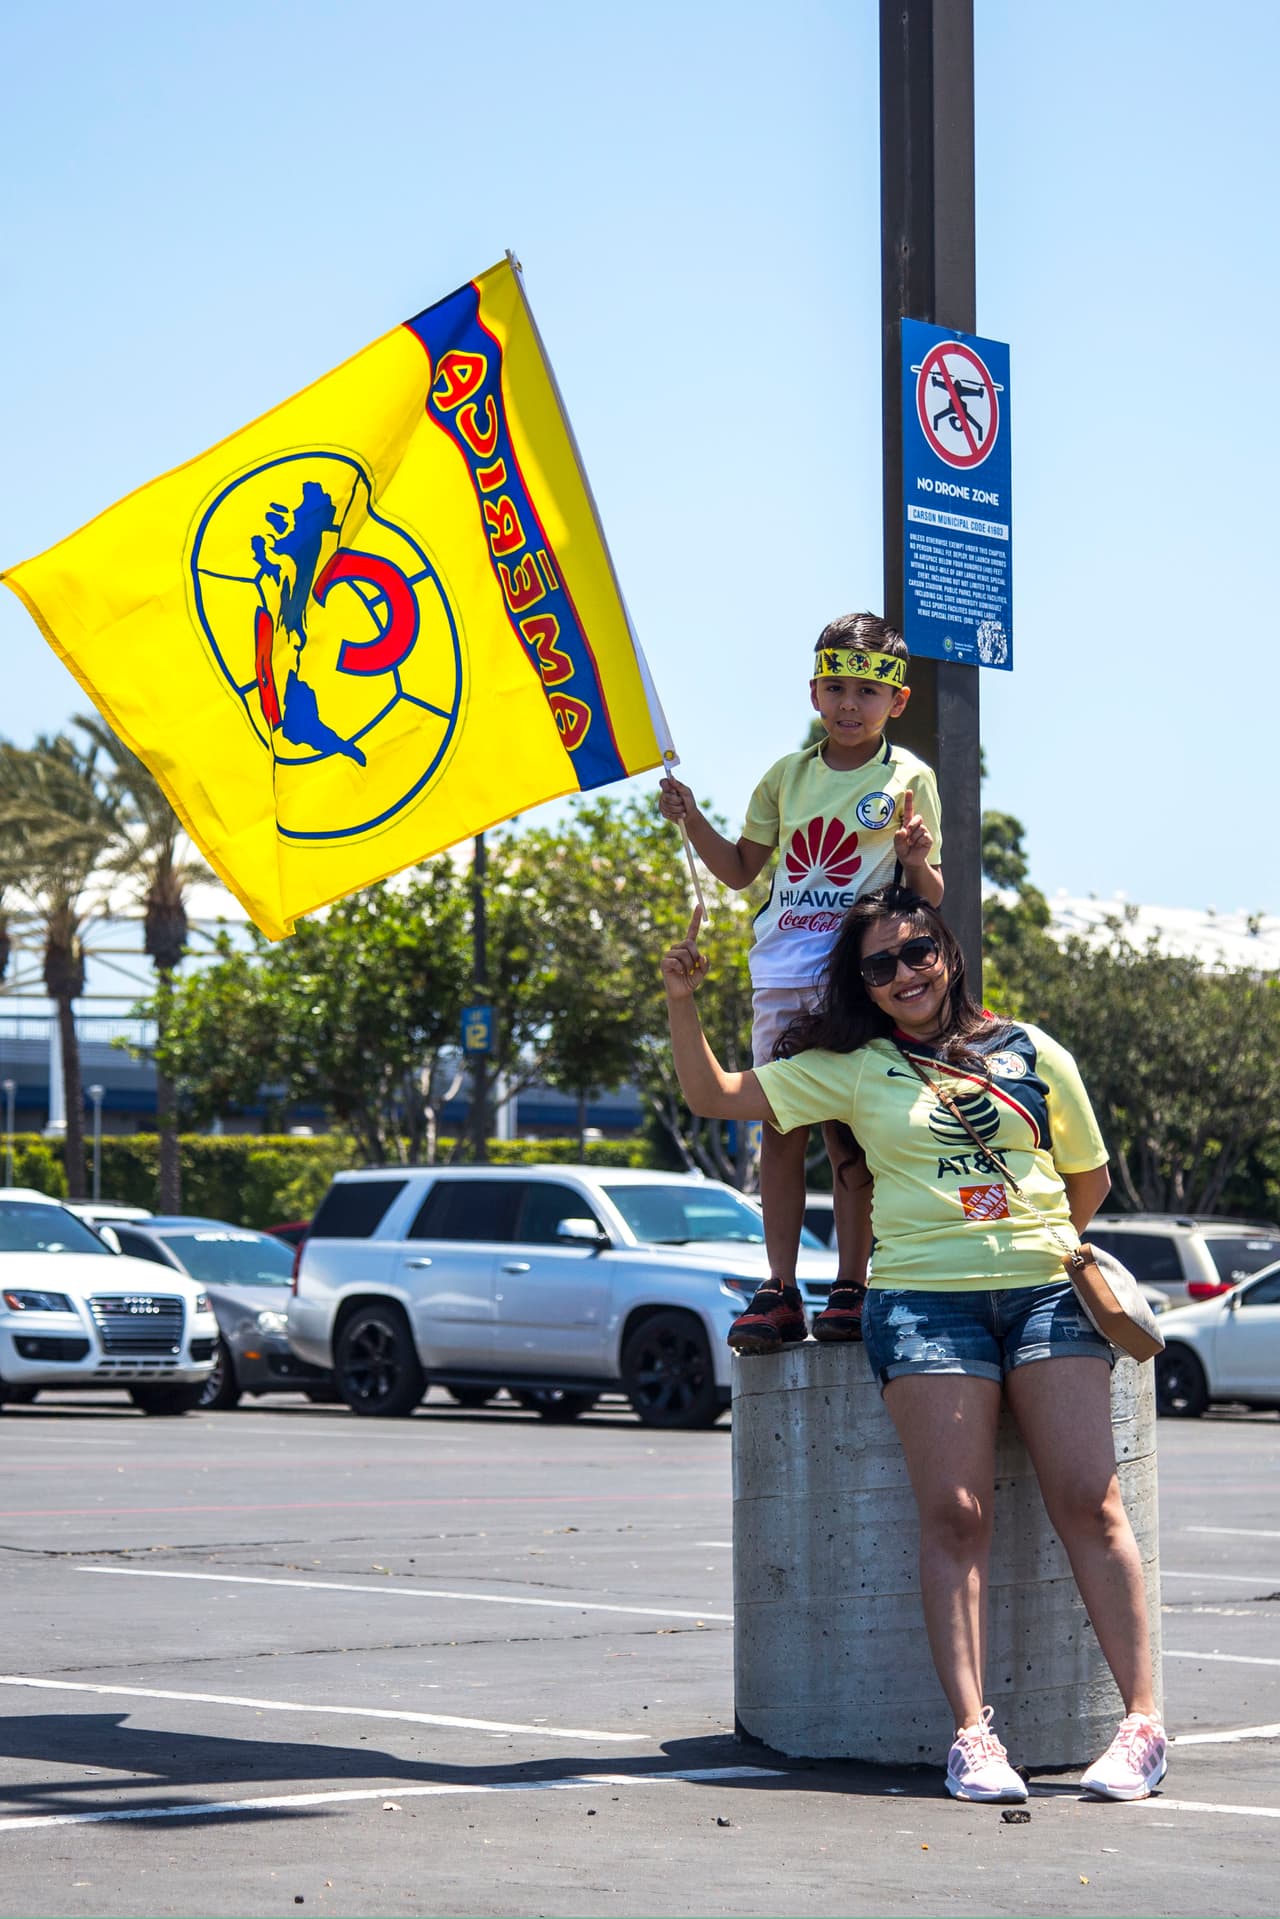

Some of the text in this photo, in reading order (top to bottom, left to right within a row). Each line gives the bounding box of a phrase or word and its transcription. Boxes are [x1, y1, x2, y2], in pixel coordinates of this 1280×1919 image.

[917, 477, 999, 506] NO DRONE ZONE
[913, 509, 935, 522] CARSON
[937, 514, 968, 529] MUNICIPAL
[971, 521, 985, 532] CODE
[916, 544, 931, 552] PERSON
[780, 890, 854, 908] HUAWE
[778, 909, 843, 933] Coca-Col
